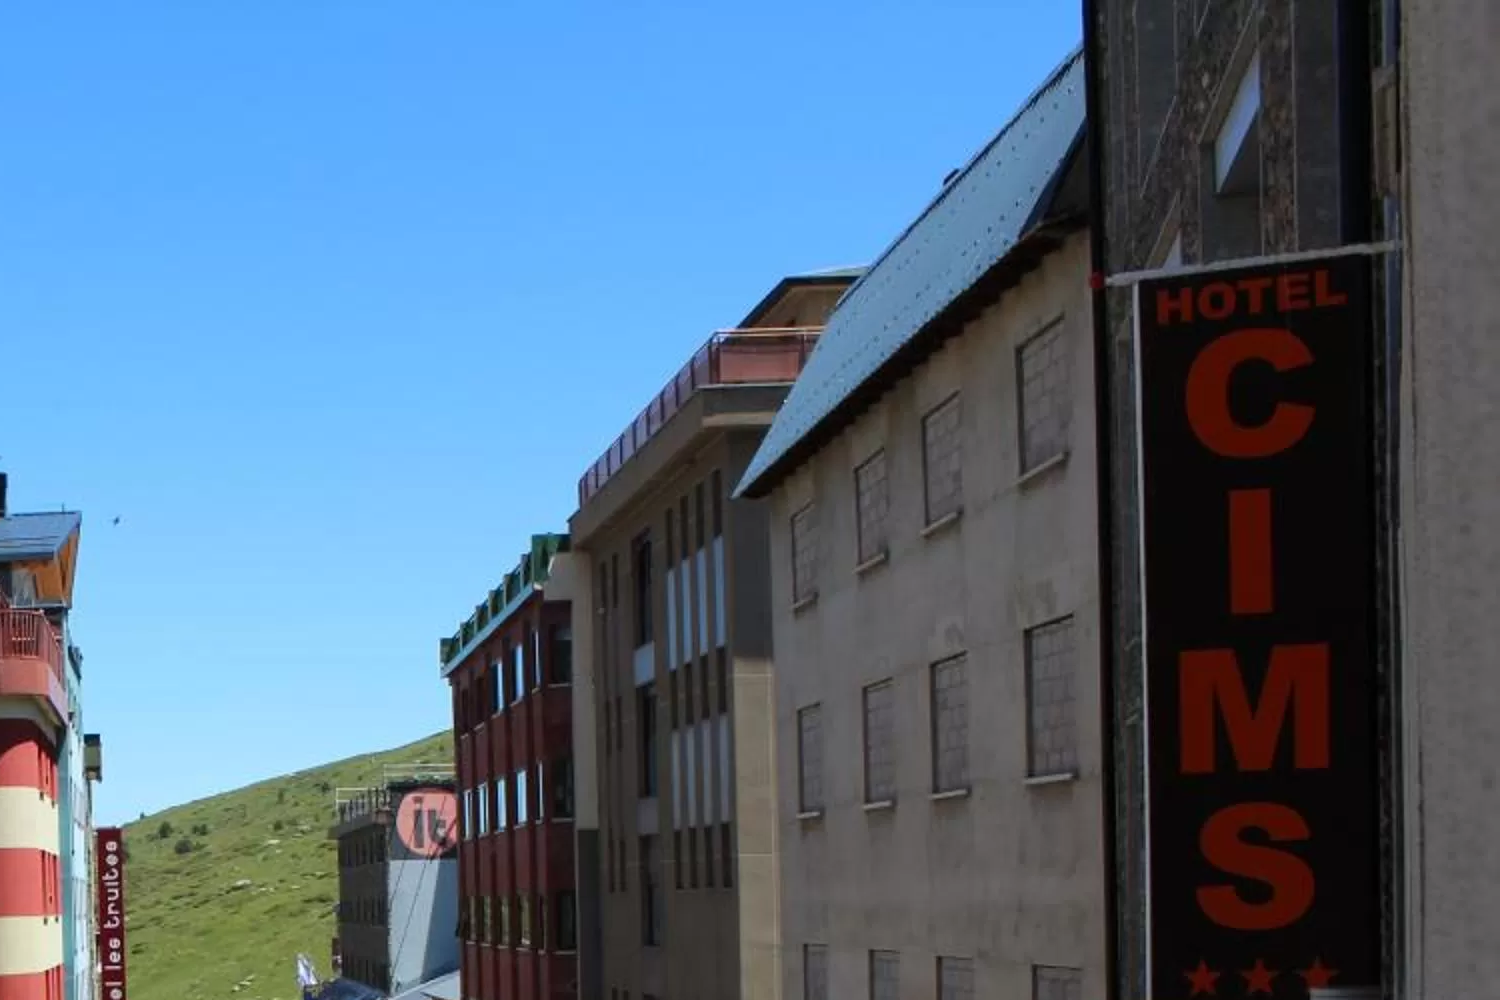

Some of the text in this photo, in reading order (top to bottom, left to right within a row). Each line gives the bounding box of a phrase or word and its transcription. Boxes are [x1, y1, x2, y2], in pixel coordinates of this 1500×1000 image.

[1156, 268, 1348, 326] HOTEL
[1178, 328, 1332, 932] CIMS
[102, 840, 120, 929] truites
[104, 938, 121, 970] les
